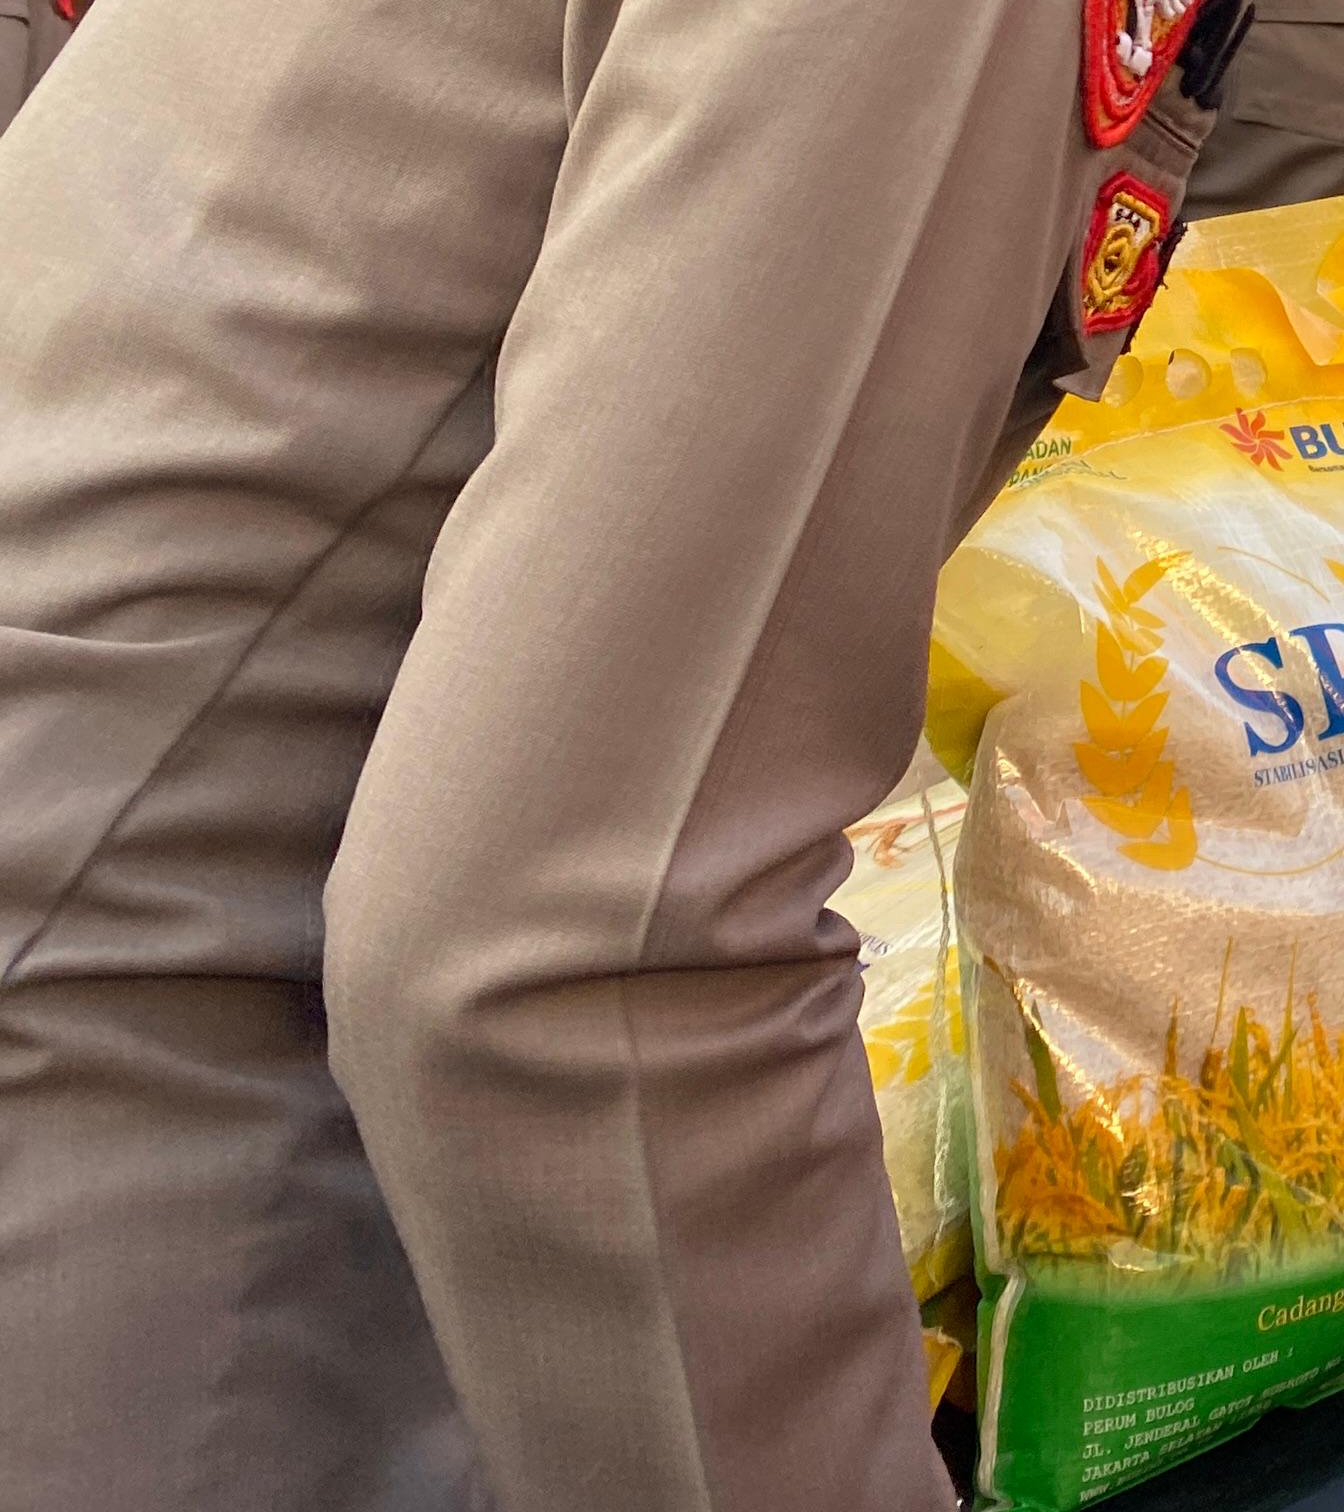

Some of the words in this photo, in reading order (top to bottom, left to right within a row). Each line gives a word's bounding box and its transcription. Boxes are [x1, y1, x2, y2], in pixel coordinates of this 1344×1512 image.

[1025, 435, 1073, 461] ADAN
[1253, 747, 1344, 787] STABILISASI
[1082, 1364, 1235, 1413] DIDISTRIBUSIKAN
[1241, 1349, 1280, 1374] OLEH
[1082, 1413, 1137, 1437] PERUM
[1145, 1397, 1196, 1421] BULOG
[1082, 1443, 1112, 1460] JL.
[1124, 1414, 1200, 1450] JENDERAL
[1081, 1449, 1150, 1483] JAKARTA
